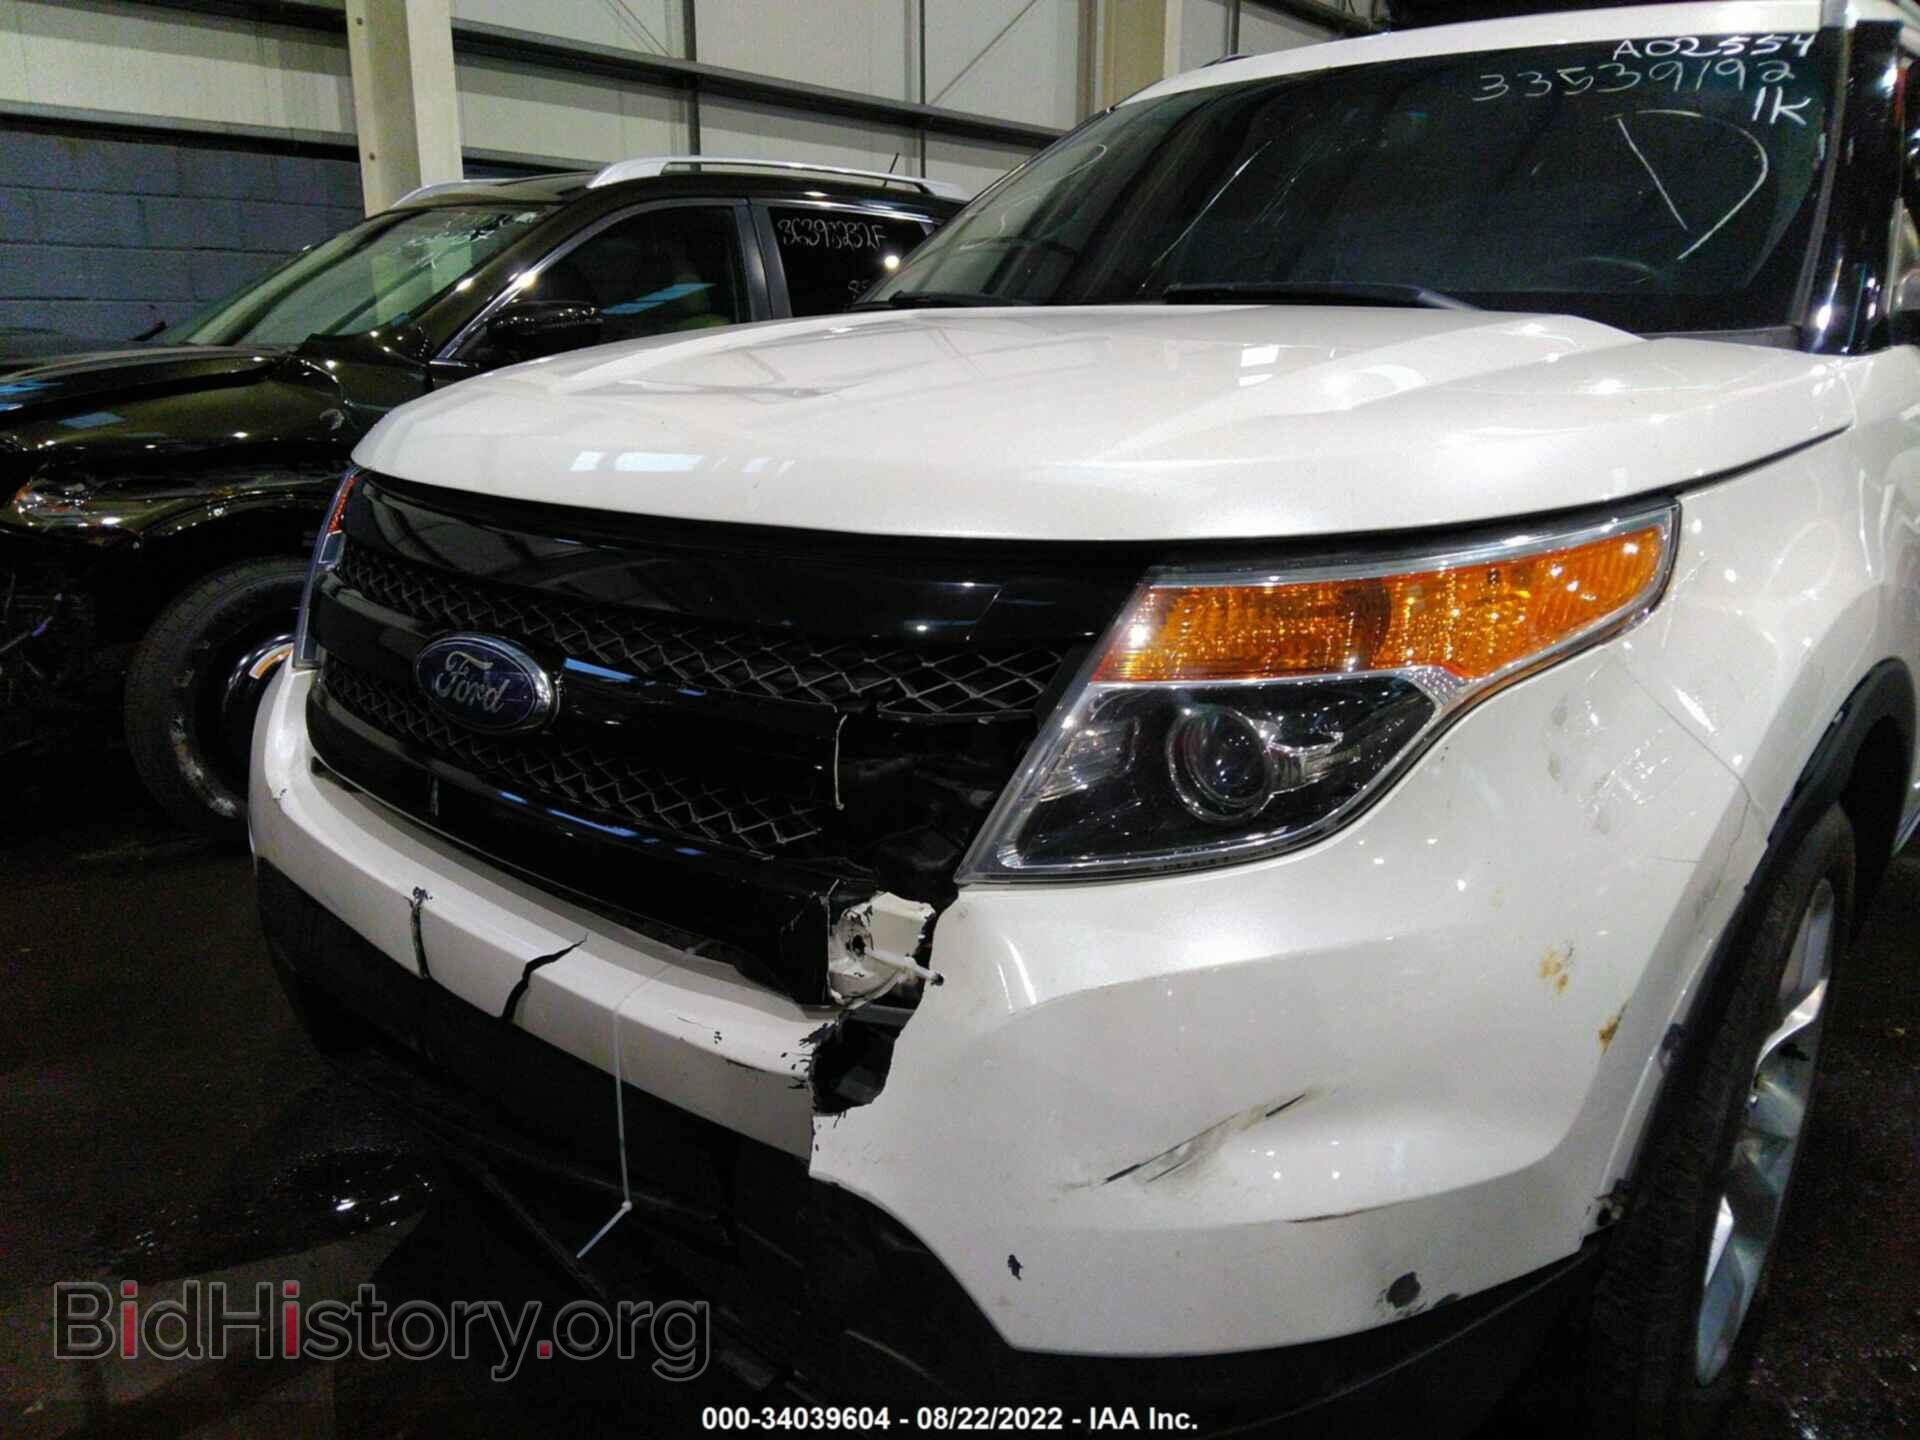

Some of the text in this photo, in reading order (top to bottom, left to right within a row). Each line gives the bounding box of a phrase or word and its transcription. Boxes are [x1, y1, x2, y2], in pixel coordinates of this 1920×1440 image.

[1613, 34, 1816, 61] A02554
[1472, 59, 1796, 101] 33539192
[434, 651, 511, 713] Ford
